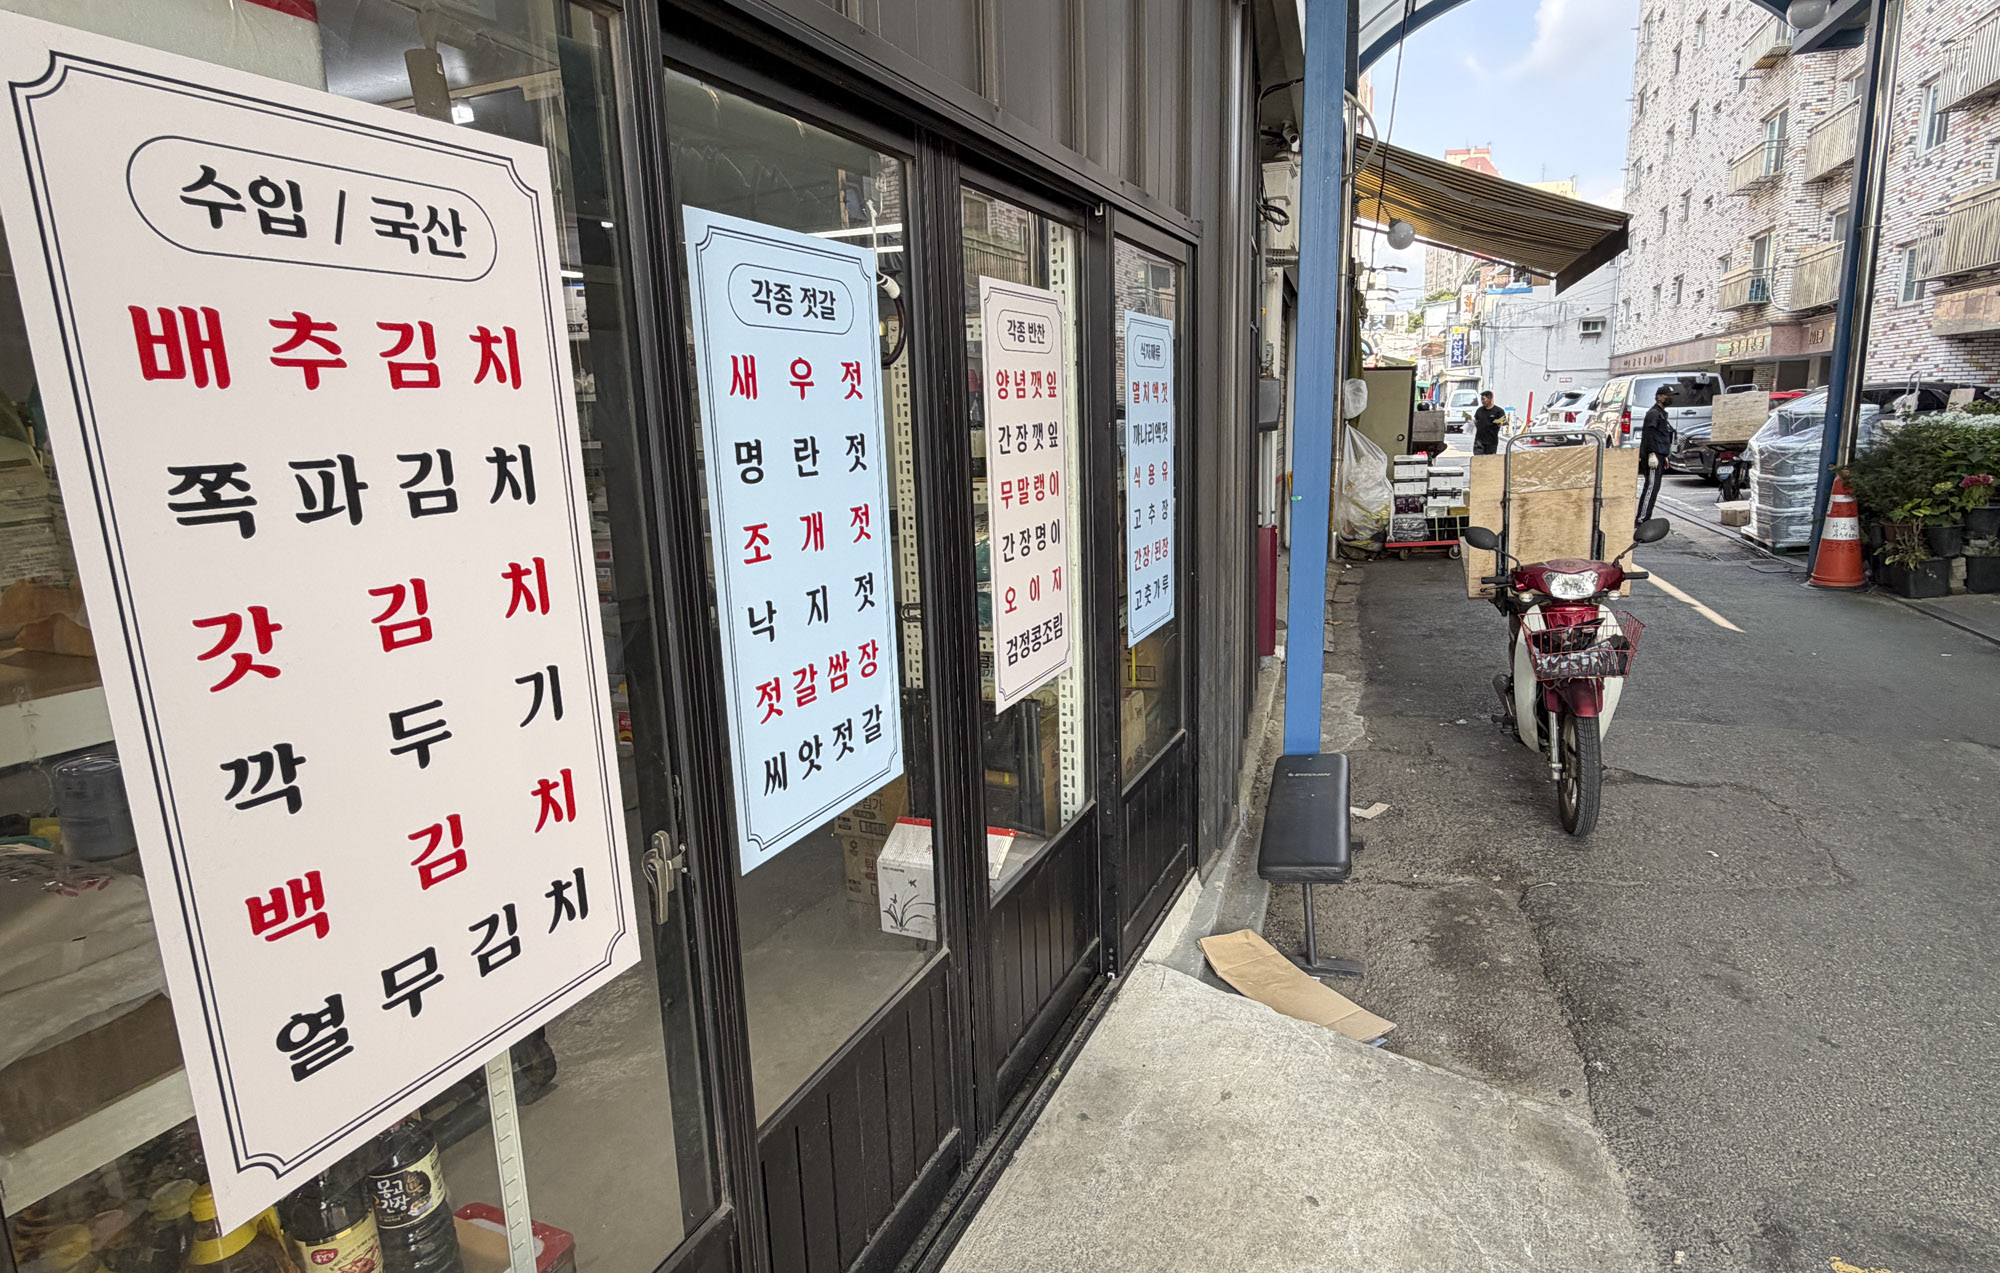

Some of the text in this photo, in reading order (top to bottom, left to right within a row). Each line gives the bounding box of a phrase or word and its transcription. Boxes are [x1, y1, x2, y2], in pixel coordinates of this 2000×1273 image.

[180, 165, 307, 238] 수입
[370, 197, 467, 259] 국산
[751, 280, 836, 320] 각종 젓갈
[128, 306, 522, 391] 배추김치
[1006, 319, 1045, 344] 각종 반찬
[997, 370, 1056, 400] 양념깻잎
[1132, 381, 1168, 404] 멸치액젓
[999, 422, 1058, 454] 간장깻잎
[1133, 422, 1168, 447] 까나리액젓
[167, 444, 536, 539] 쪽파김치
[1001, 472, 1059, 509] 무말랭이
[1003, 519, 1060, 562] 간장명이
[1134, 537, 1169, 571] 간장/된장
[1135, 575, 1168, 610] 고춧가루
[1007, 613, 1062, 666] 검정콩조림
[756, 640, 878, 724] 젓갈쌈장
[764, 704, 882, 796] 씨앗젓갈
[276, 868, 588, 1082] 열무김치
[377, 1180, 404, 1199] 몽고
[380, 1194, 411, 1213] 간장
